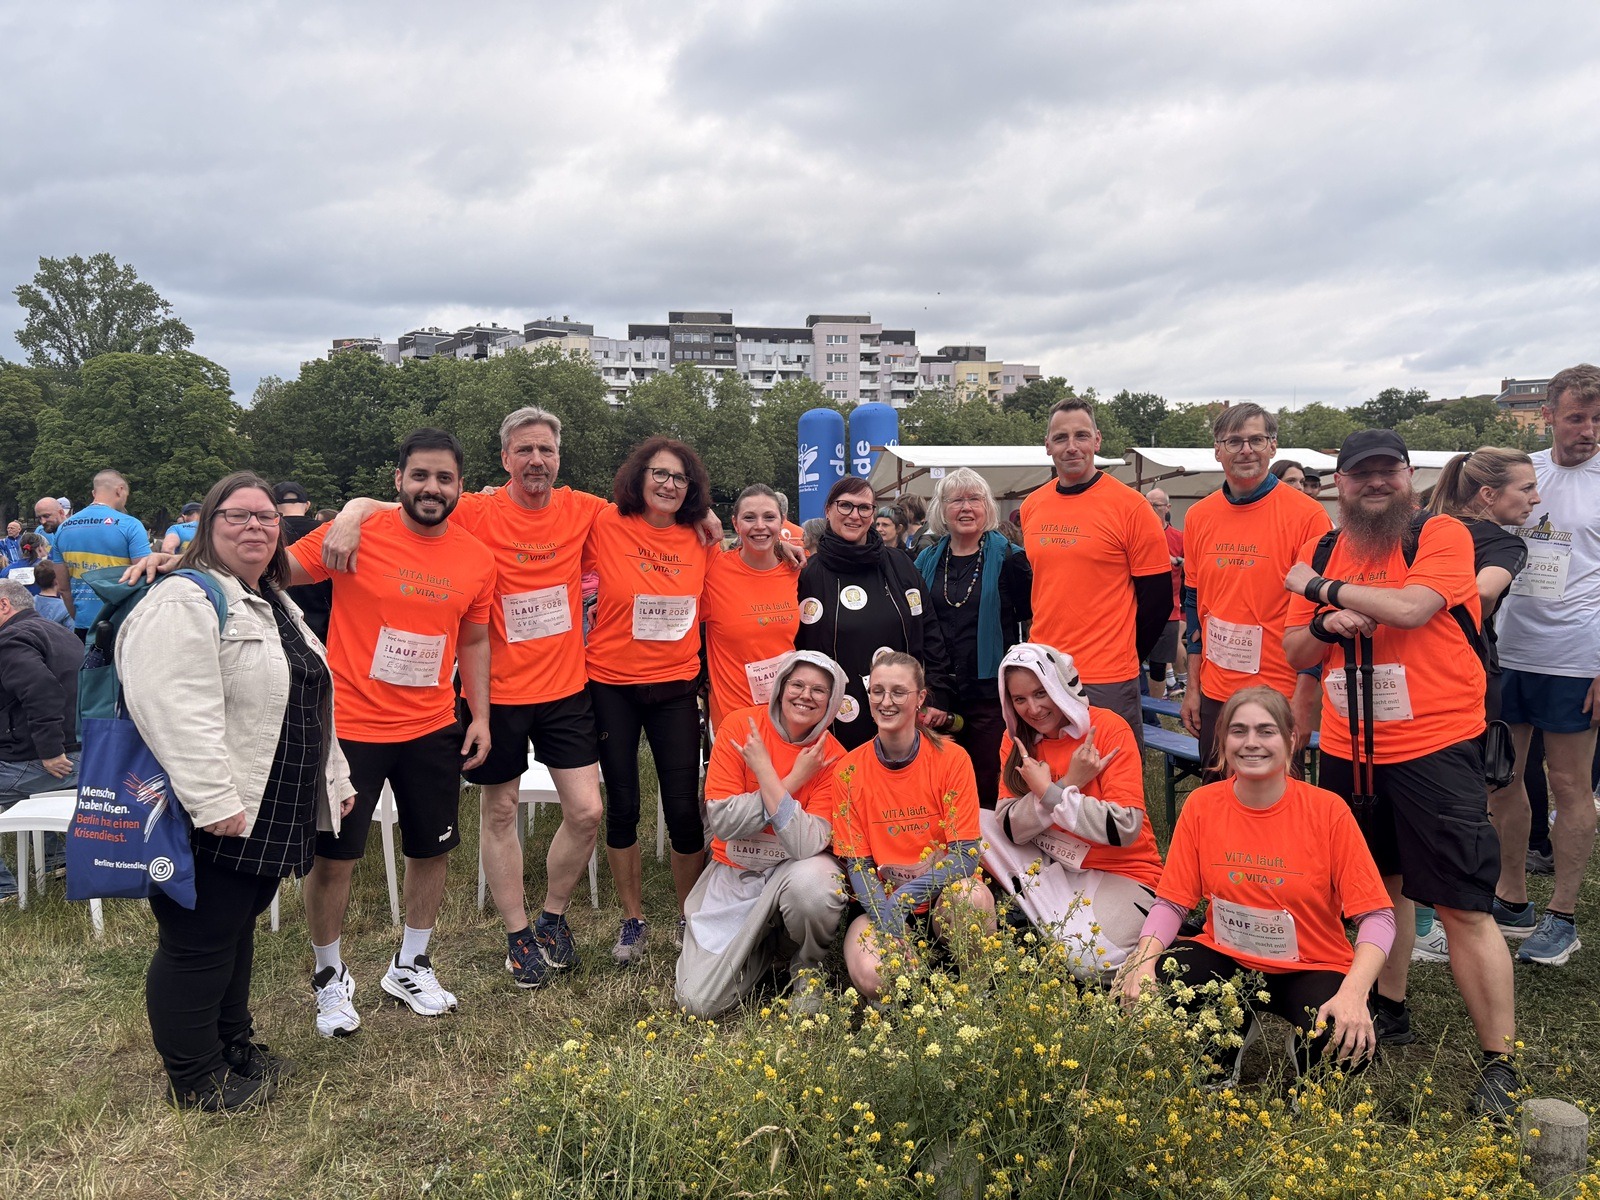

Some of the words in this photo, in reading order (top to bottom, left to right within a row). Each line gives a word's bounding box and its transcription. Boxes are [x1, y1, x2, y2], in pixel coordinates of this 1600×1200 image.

[829, 443, 845, 476] de
[853, 440, 871, 475] de
[513, 541, 534, 550] VITA
[1238, 544, 1259, 554] läuft.
[638, 547, 659, 560] VITA
[660, 552, 682, 563] läuft.
[1228, 558, 1245, 566] VITA
[653, 564, 670, 573] VITA
[1534, 563, 1559, 573] 2026
[399, 567, 423, 581] VITA
[427, 573, 453, 588] läuft.
[415, 587, 435, 598] VITA
[514, 604, 540, 616] LAUF
[541, 599, 562, 611] 2026
[642, 608, 667, 616] LAUF
[751, 603, 772, 612] VITA
[1210, 630, 1228, 642] LAUF
[1229, 637, 1253, 647] 2026
[388, 645, 418, 658] LAUF
[419, 650, 439, 660] 2026
[757, 670, 778, 682] LAU
[1372, 681, 1397, 690] 026
[81, 786, 115, 800] Menschn
[78, 798, 102, 812] haben
[882, 808, 905, 819] VITA
[907, 805, 929, 817] läuft.
[76, 813, 100, 826] Berlin
[113, 818, 140, 829] einen
[900, 823, 920, 832] VITA
[736, 845, 761, 854] LAUF
[763, 849, 786, 859] 2026
[1035, 838, 1056, 851] LAUF
[1056, 847, 1077, 861] 2026
[94, 858, 115, 868] Berliner
[1225, 851, 1253, 864] VITA
[1256, 854, 1287, 869] läuft.
[1245, 872, 1269, 884] VITA
[1221, 914, 1251, 930] LAUF
[1253, 923, 1285, 934] 2026
